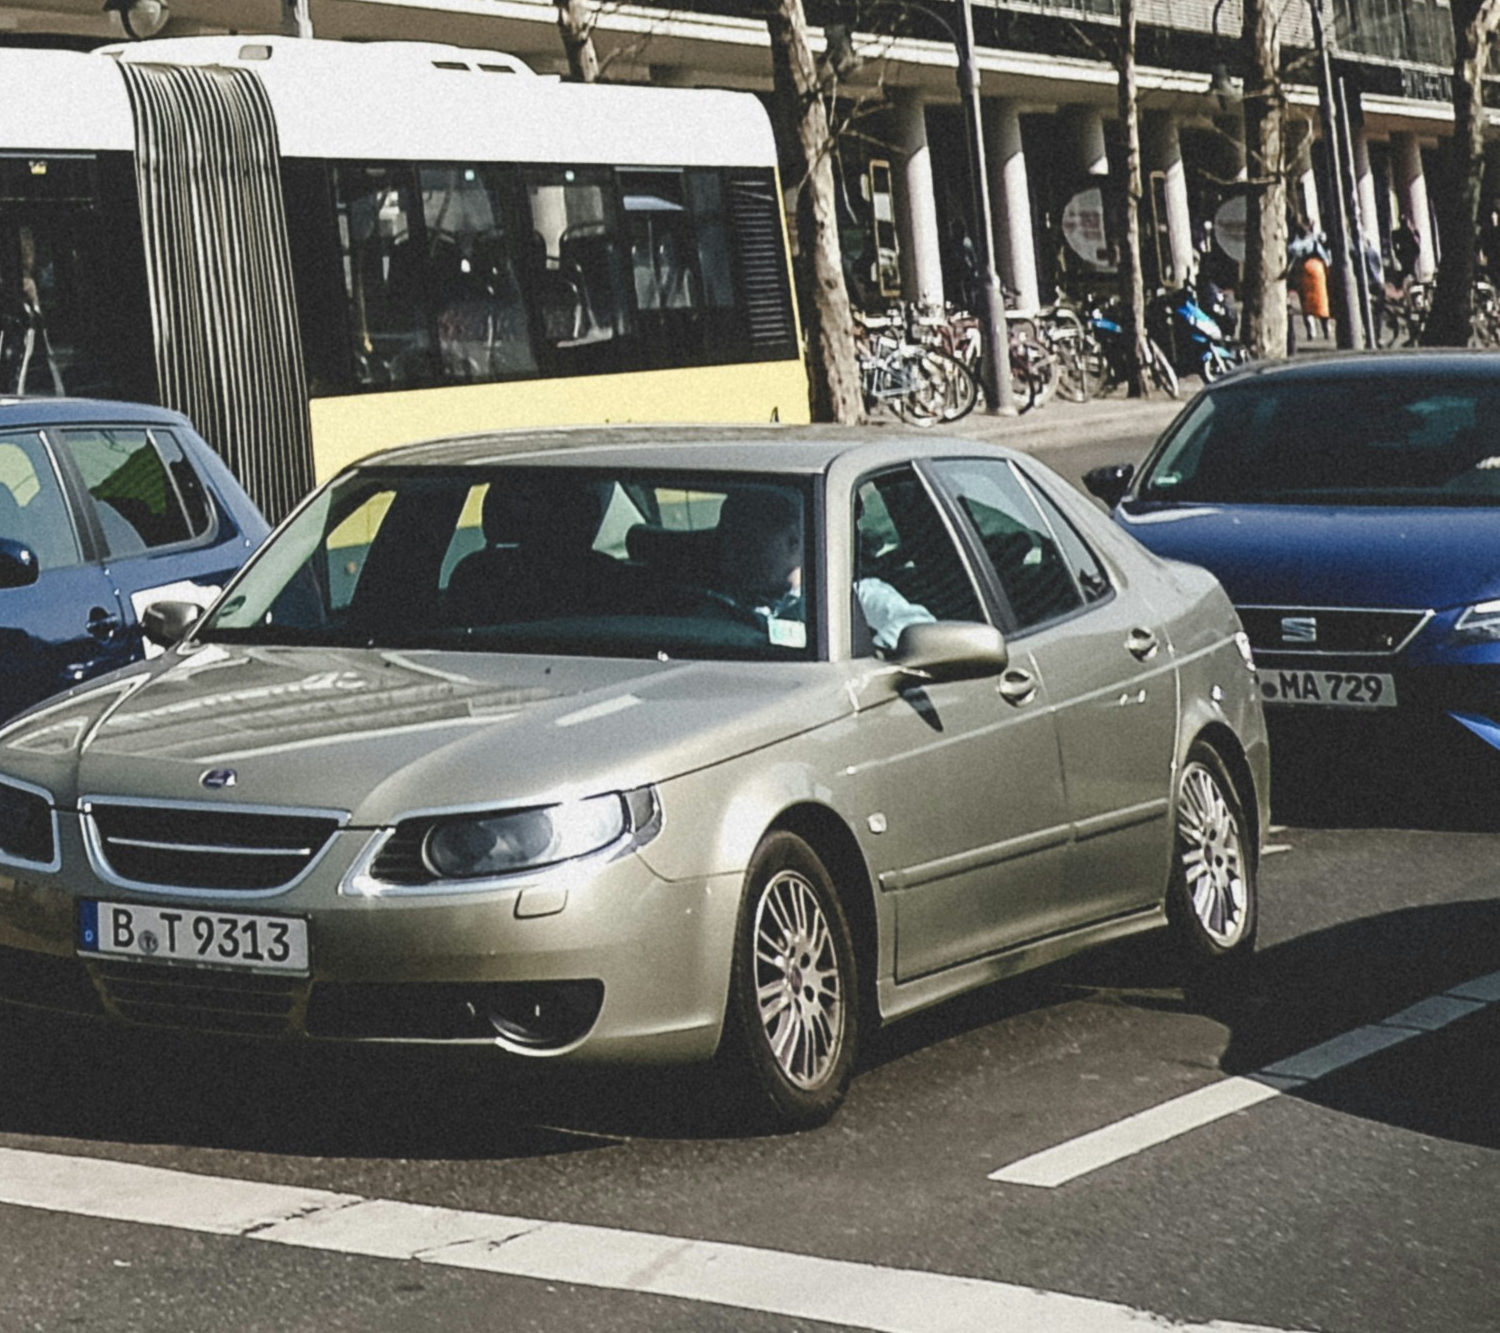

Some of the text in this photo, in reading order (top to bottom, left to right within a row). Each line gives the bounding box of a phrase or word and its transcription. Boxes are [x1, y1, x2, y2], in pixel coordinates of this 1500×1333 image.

[1279, 671, 1383, 703] MA 729
[112, 908, 135, 948] B
[159, 912, 182, 953] T
[192, 916, 290, 962] 9313
